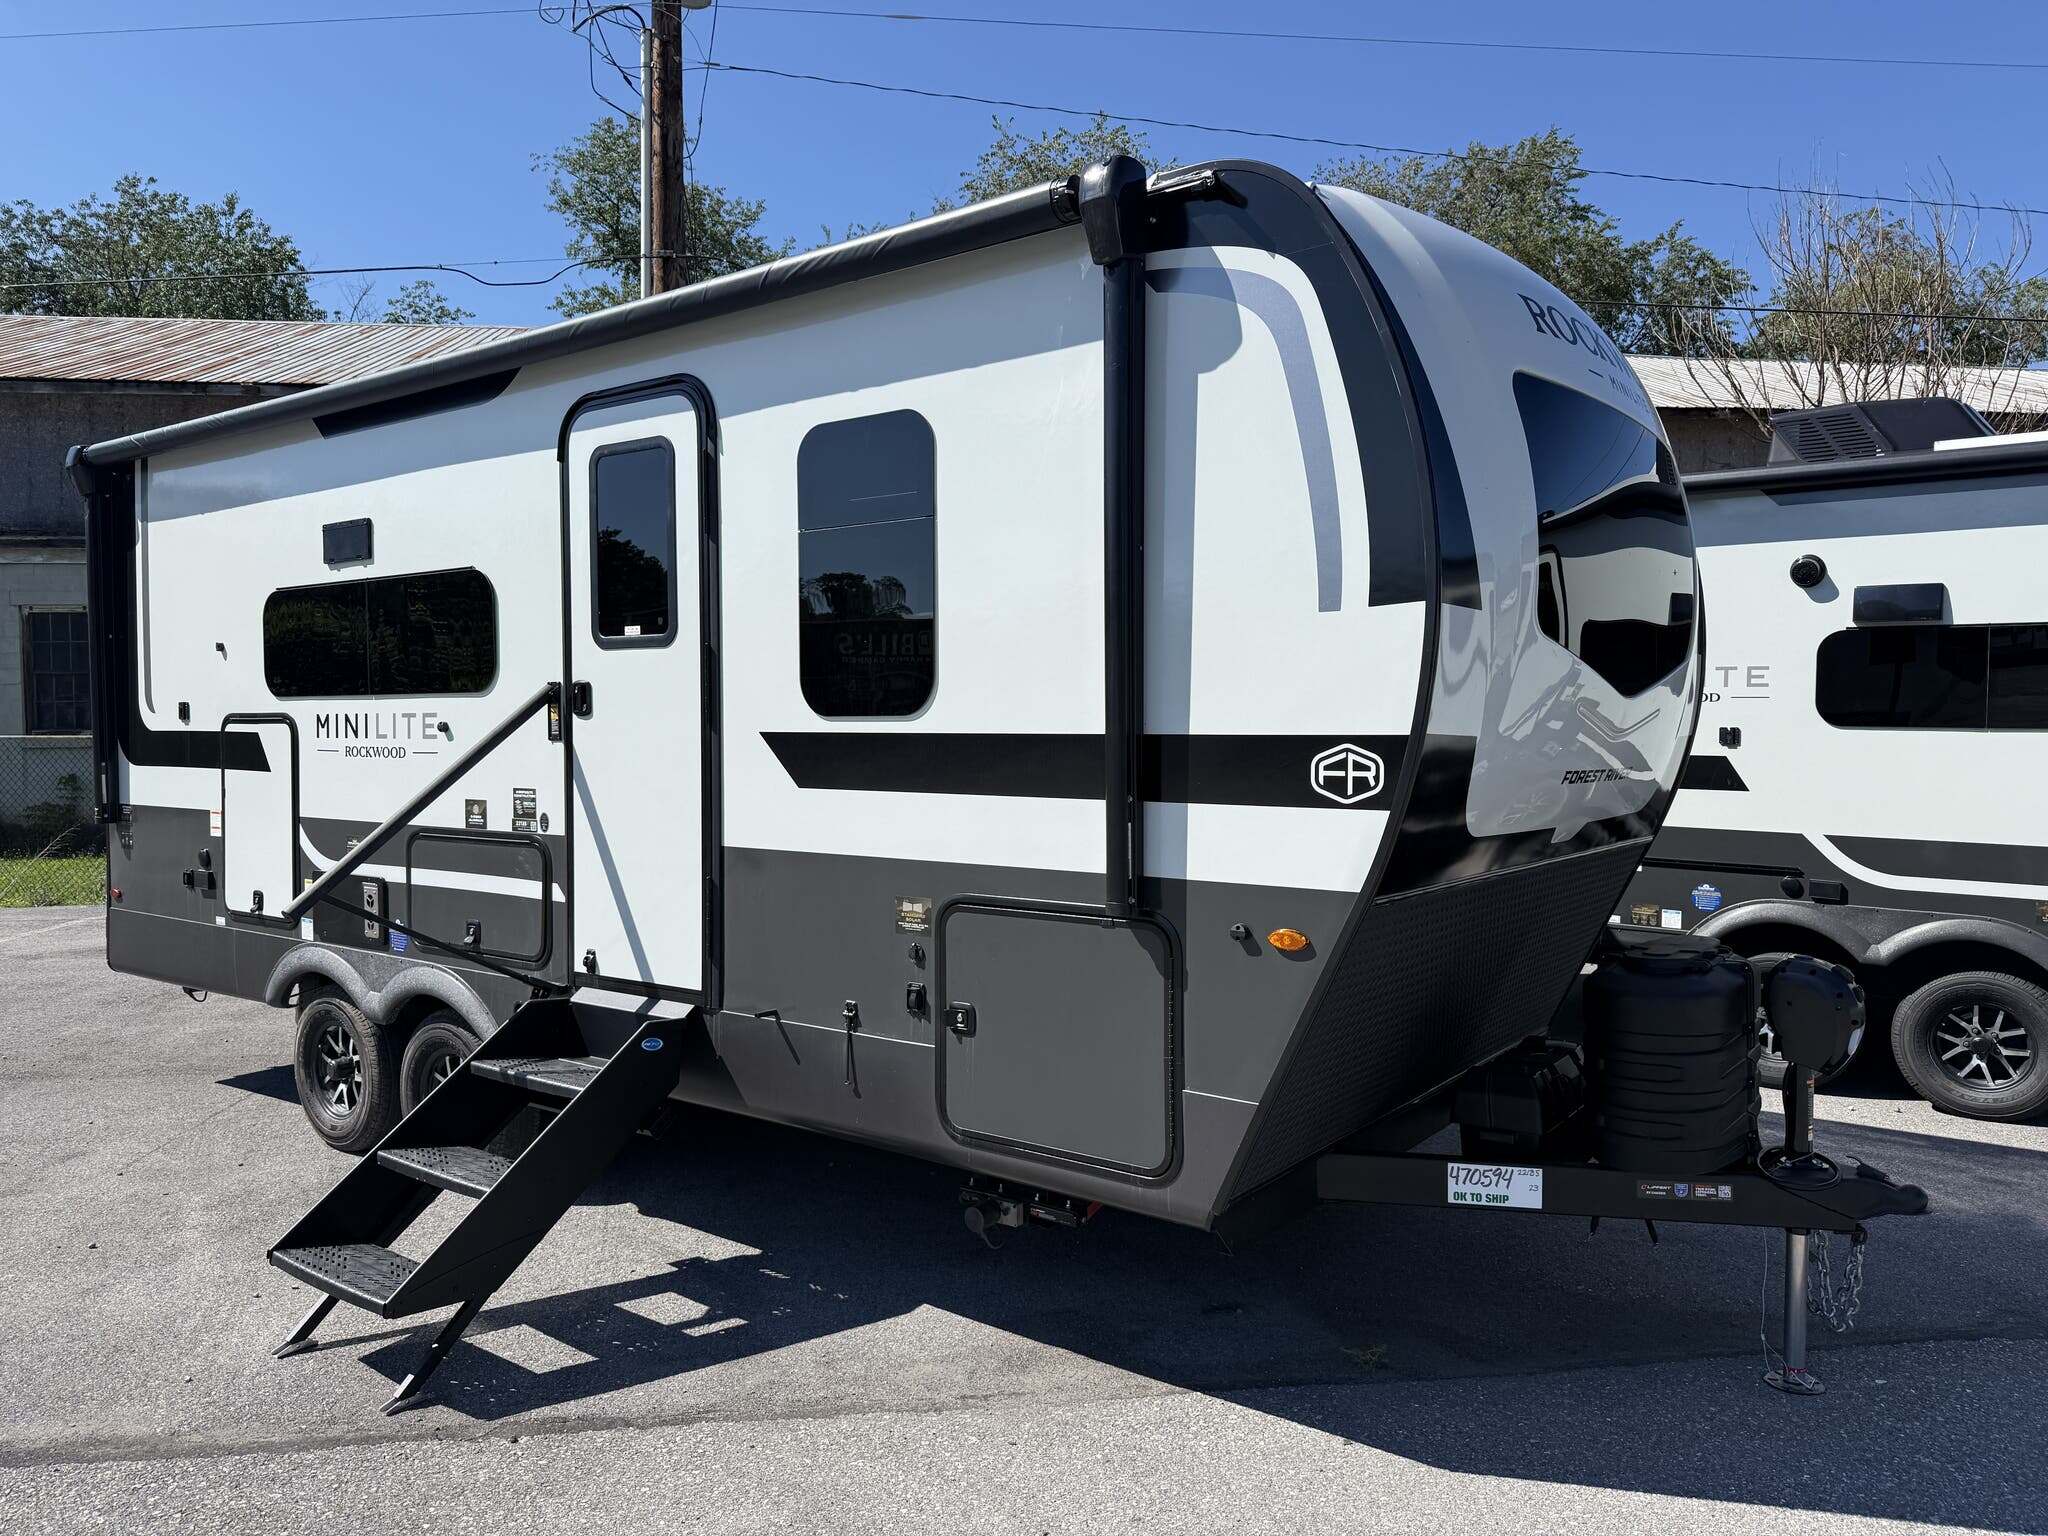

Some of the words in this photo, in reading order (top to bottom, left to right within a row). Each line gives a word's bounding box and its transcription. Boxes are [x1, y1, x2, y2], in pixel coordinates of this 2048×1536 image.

[344, 745, 407, 759] ROCKWOOD
[1561, 768, 1607, 785] FOREST
[1449, 1165, 1514, 1190] 470594
[1528, 1184, 1540, 1192] 23
[1453, 1191, 1468, 1202] OK
[1470, 1192, 1483, 1203] TO
[1485, 1193, 1510, 1204] SHIP
